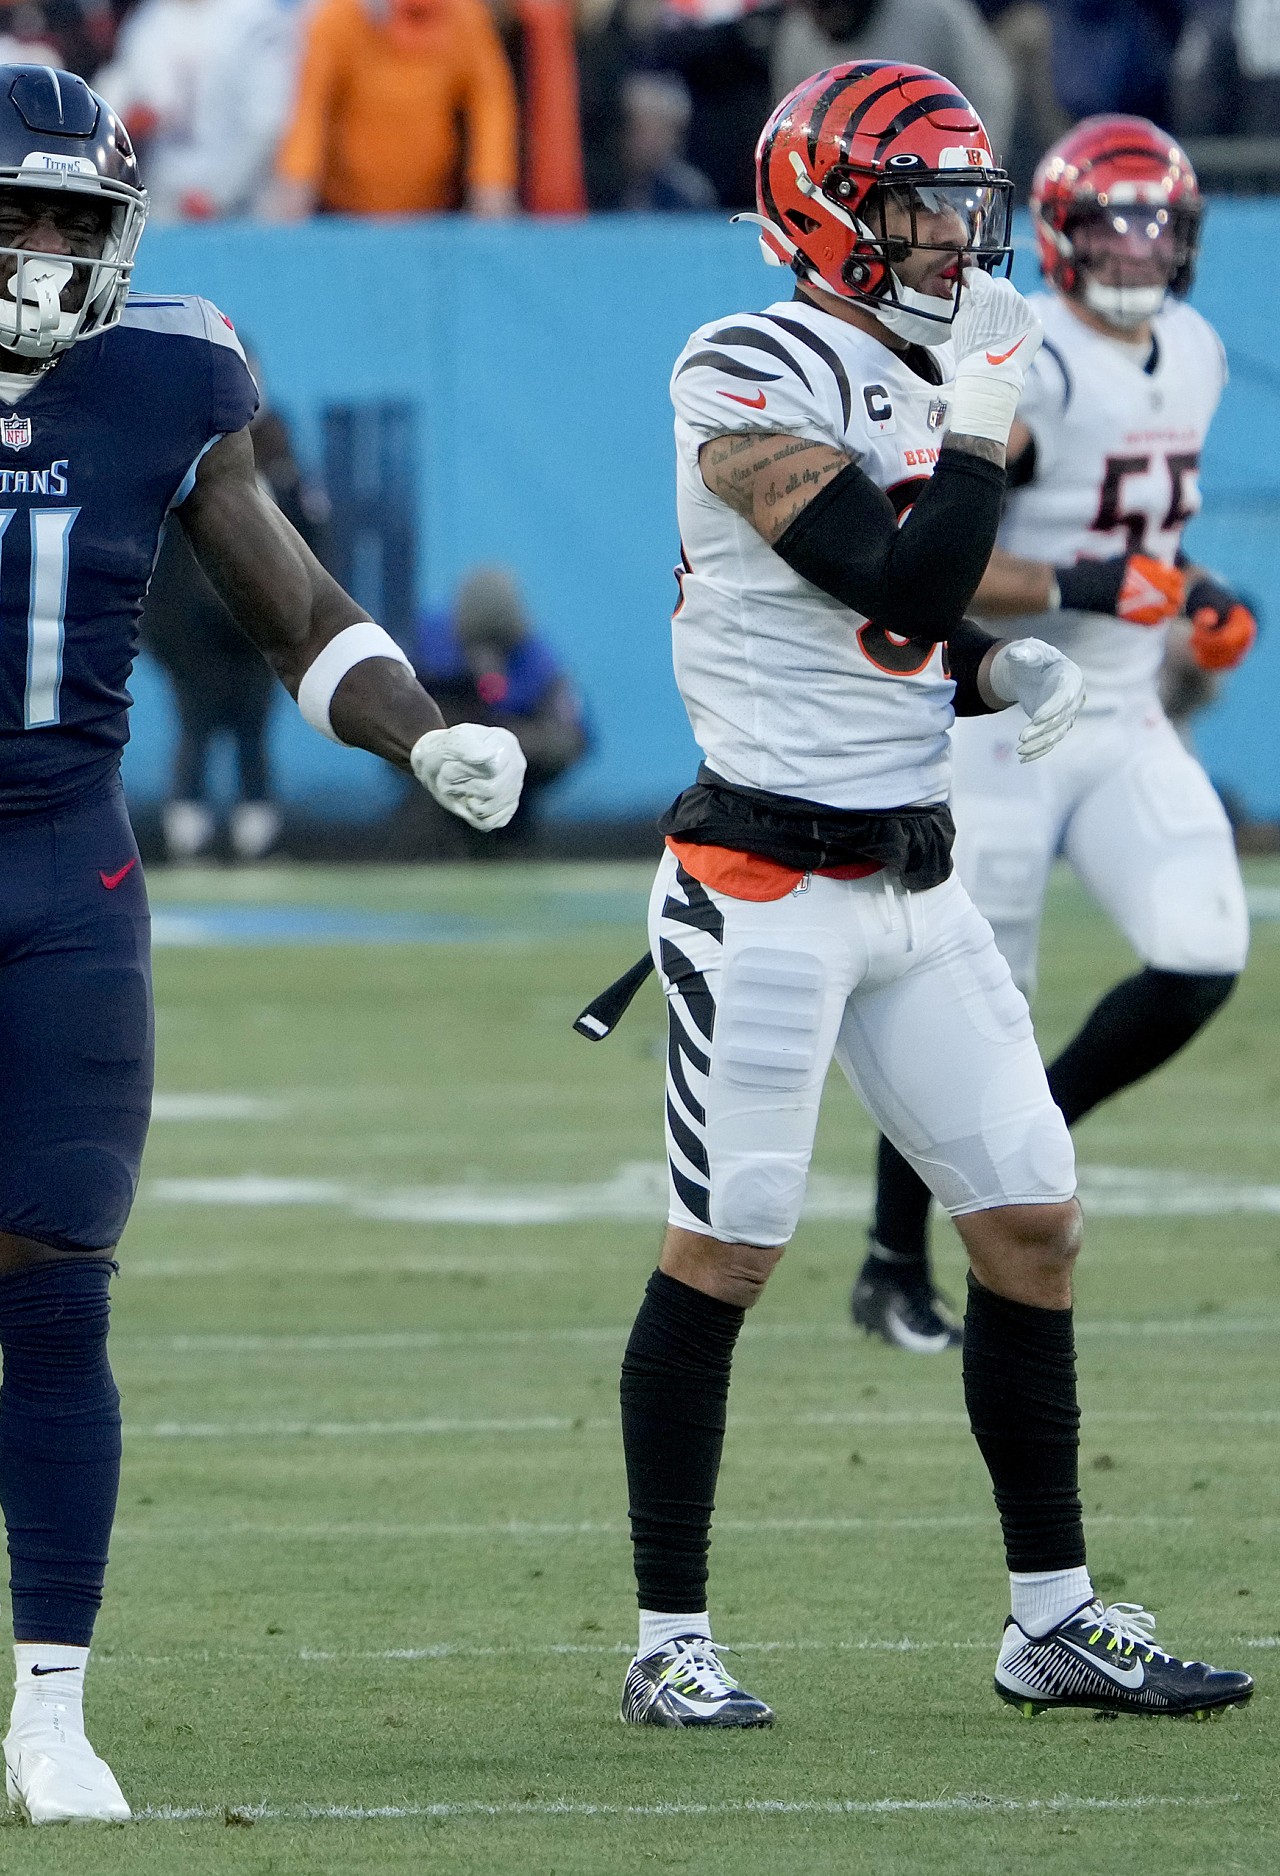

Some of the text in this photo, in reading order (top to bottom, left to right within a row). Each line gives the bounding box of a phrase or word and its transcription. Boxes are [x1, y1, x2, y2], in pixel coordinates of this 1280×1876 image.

[863, 384, 892, 421] C
[7, 430, 27, 444] NFL
[1088, 453, 1200, 553] 55
